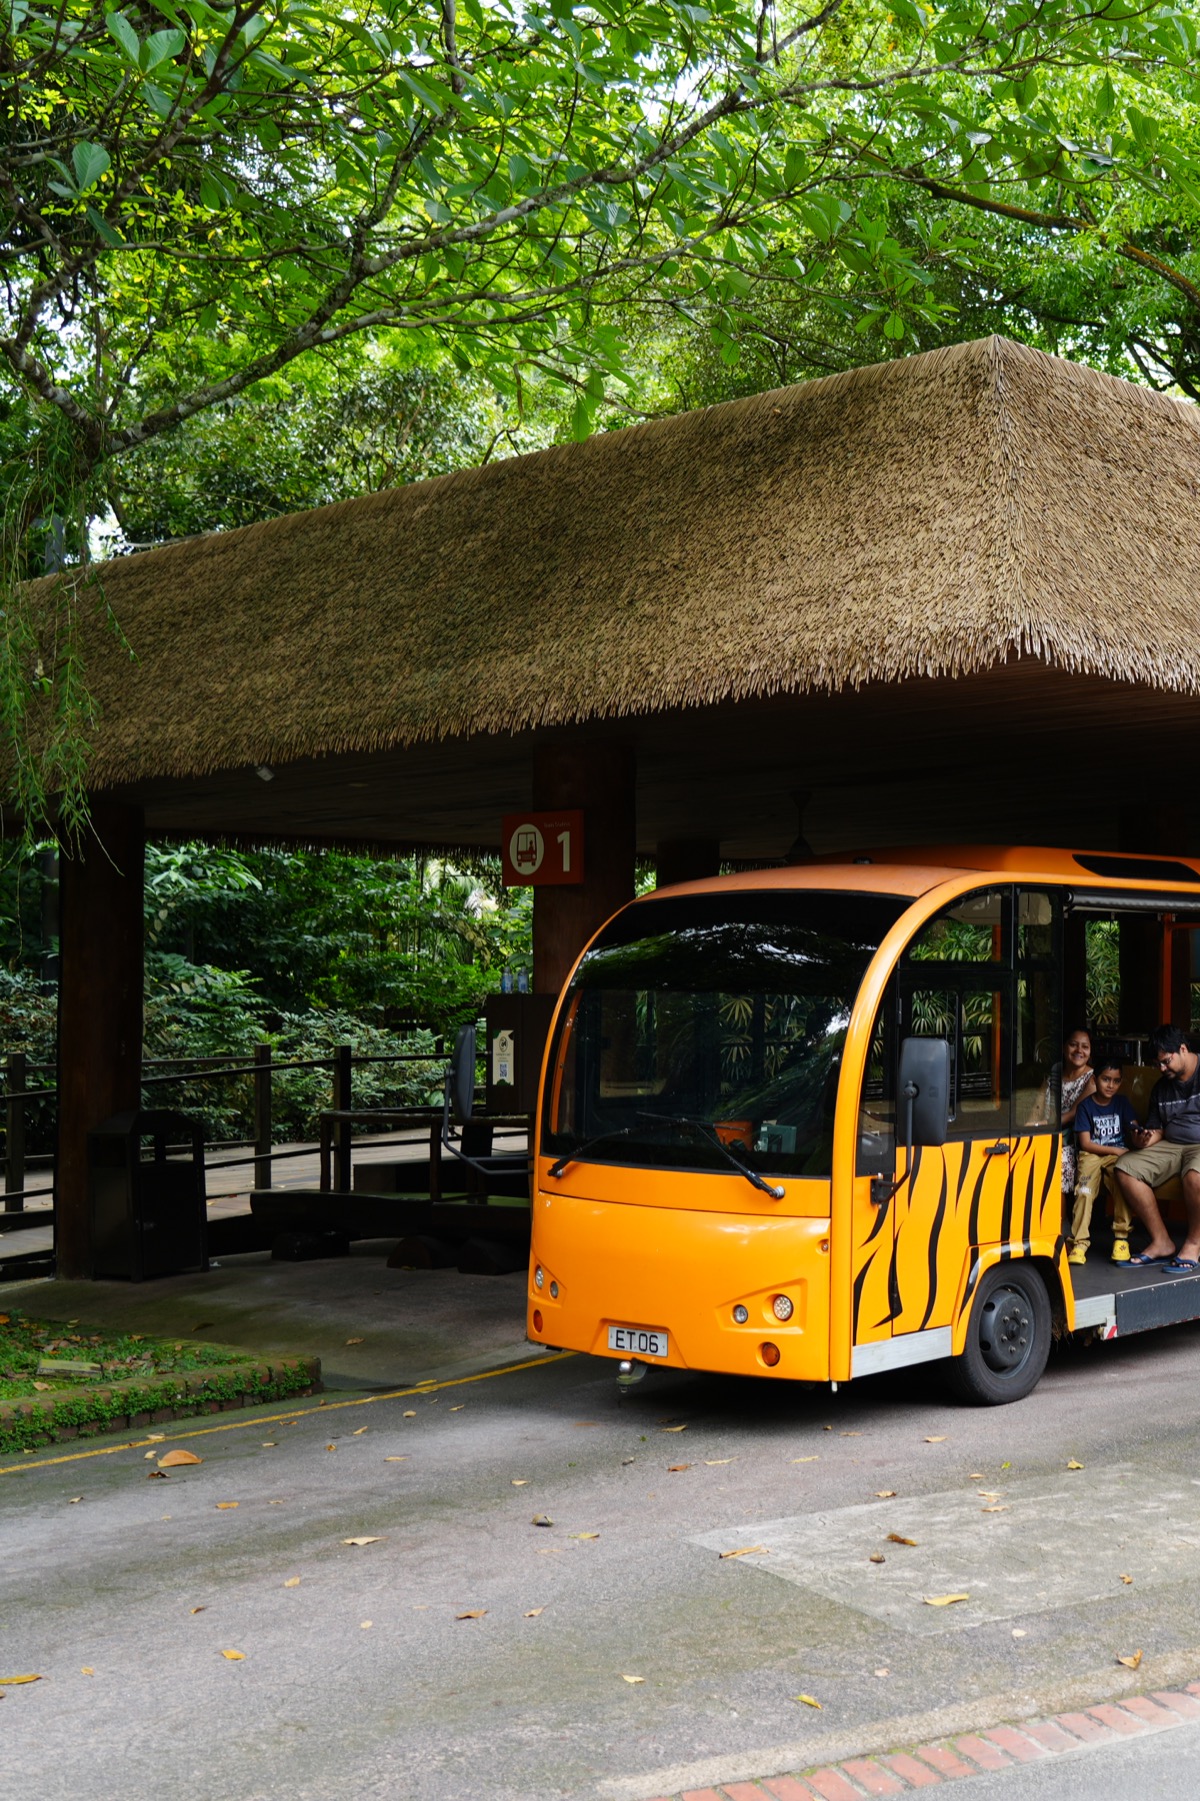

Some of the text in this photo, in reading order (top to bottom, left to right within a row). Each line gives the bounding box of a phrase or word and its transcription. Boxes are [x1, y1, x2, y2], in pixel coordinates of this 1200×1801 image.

[557, 831, 570, 872] 1
[1094, 1118, 1116, 1126] PARTY
[616, 1329, 659, 1353] ET06
